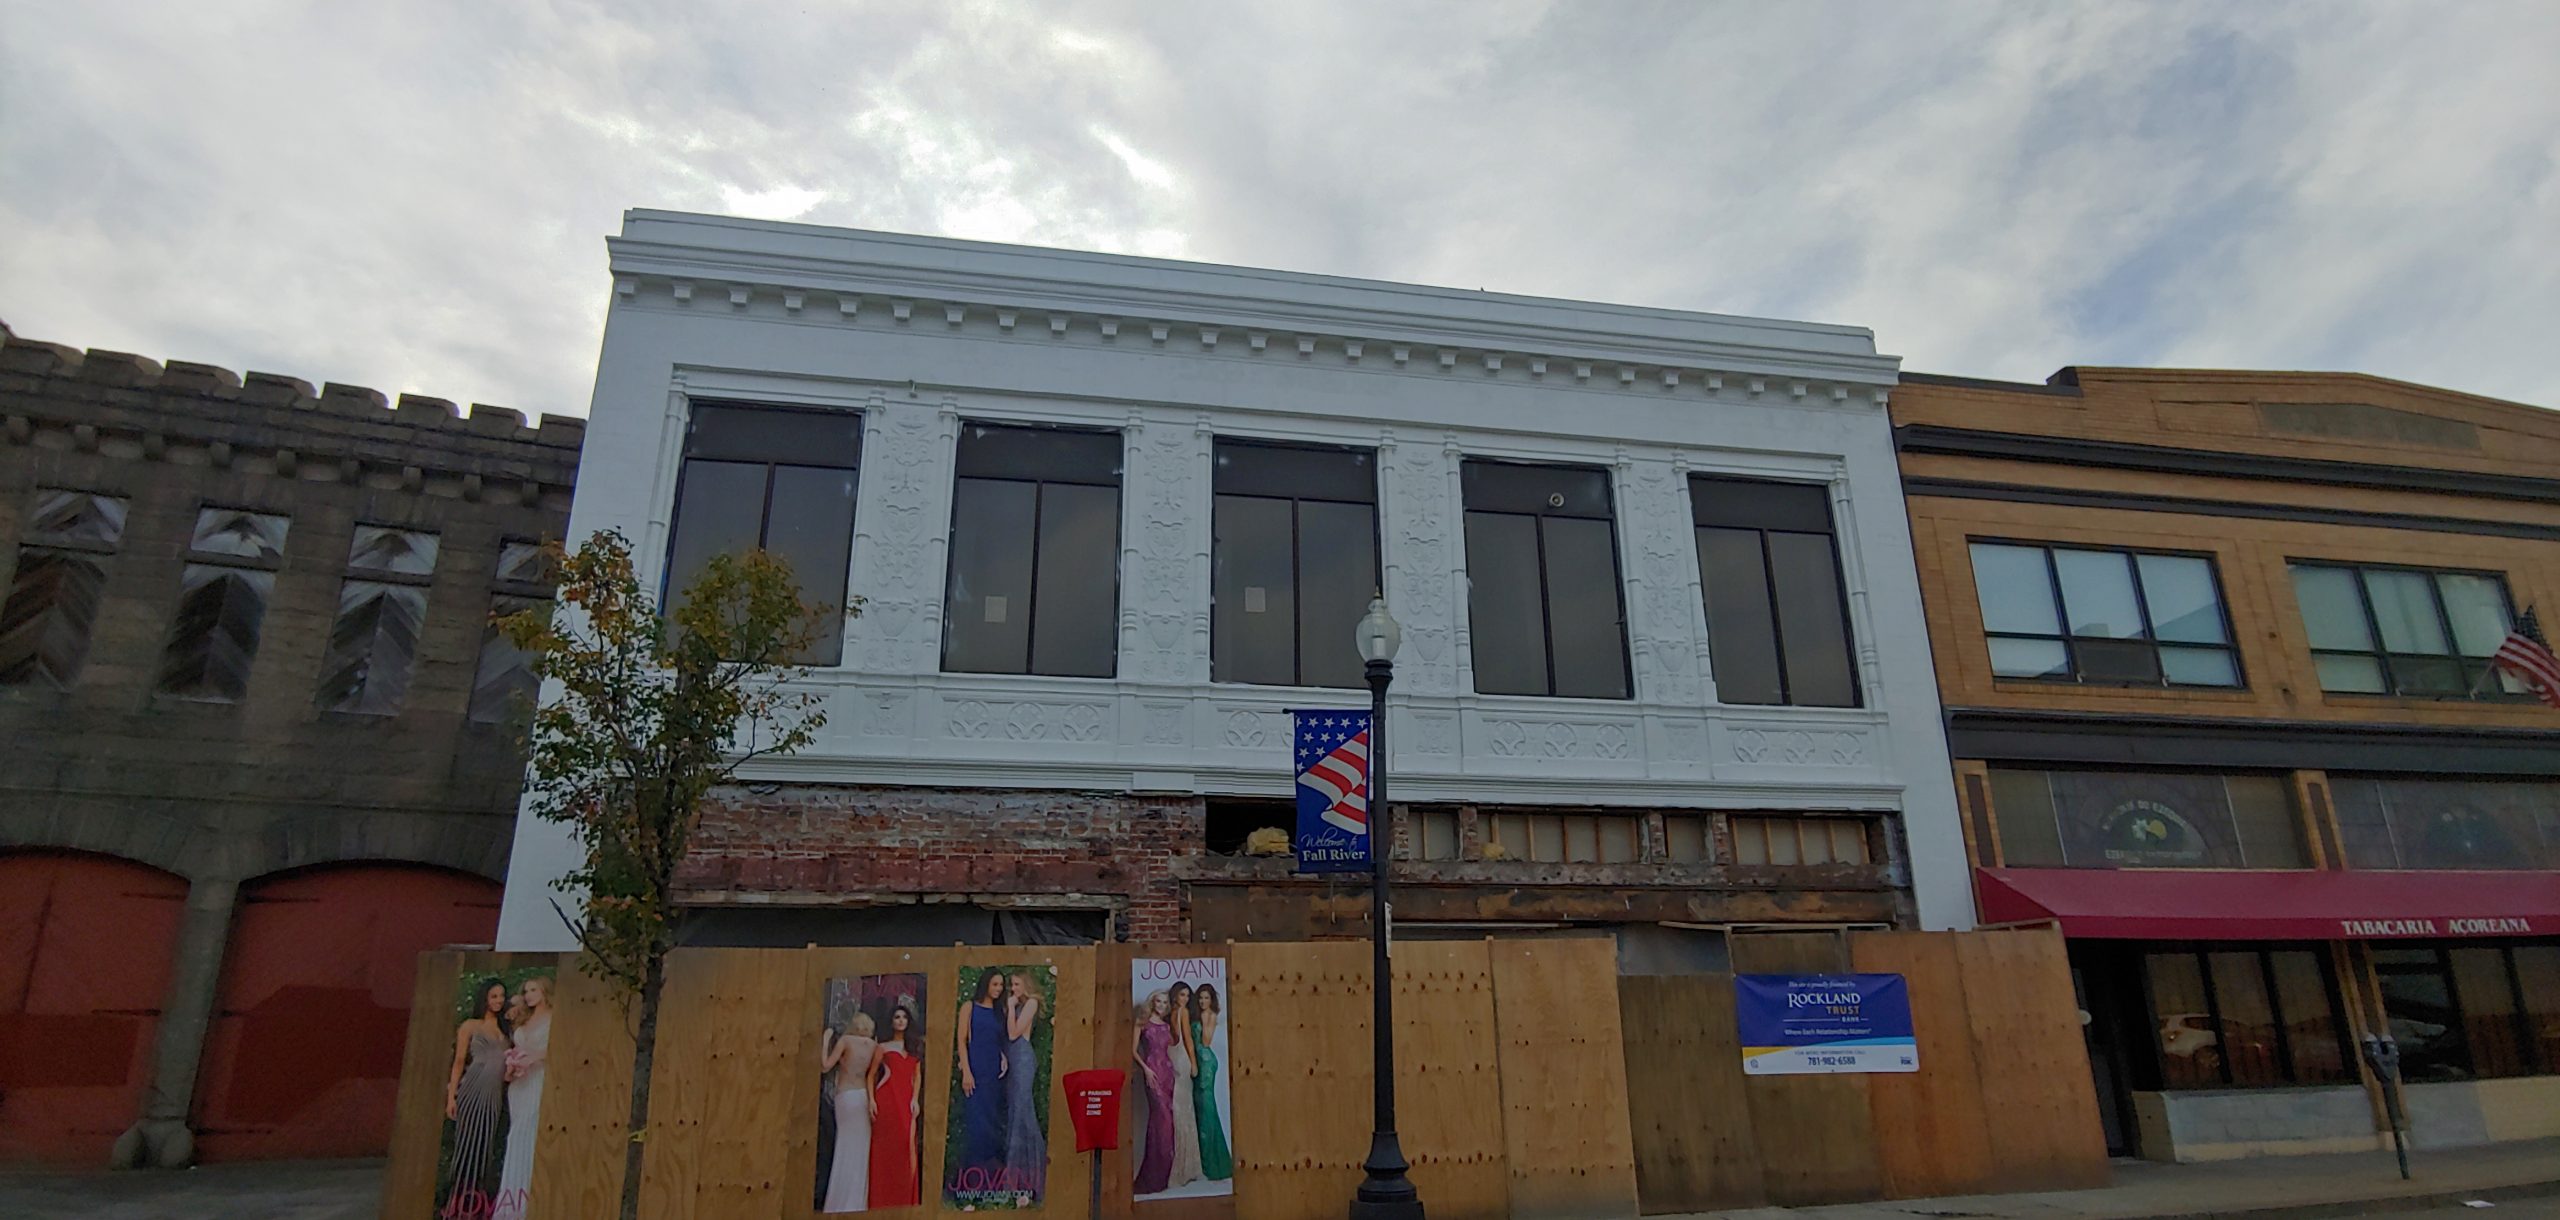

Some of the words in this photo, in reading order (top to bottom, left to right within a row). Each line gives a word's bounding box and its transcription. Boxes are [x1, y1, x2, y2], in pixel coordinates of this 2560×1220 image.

[1302, 848, 1327, 861] Fall
[1330, 848, 1366, 860] River
[2341, 920, 2437, 935] TABACARIA
[2449, 918, 2531, 936] AÇOREANA
[1141, 959, 1219, 980] JOVANI
[1788, 993, 1861, 1008] ROCKLAND
[1826, 1006, 1860, 1015] TRUST
